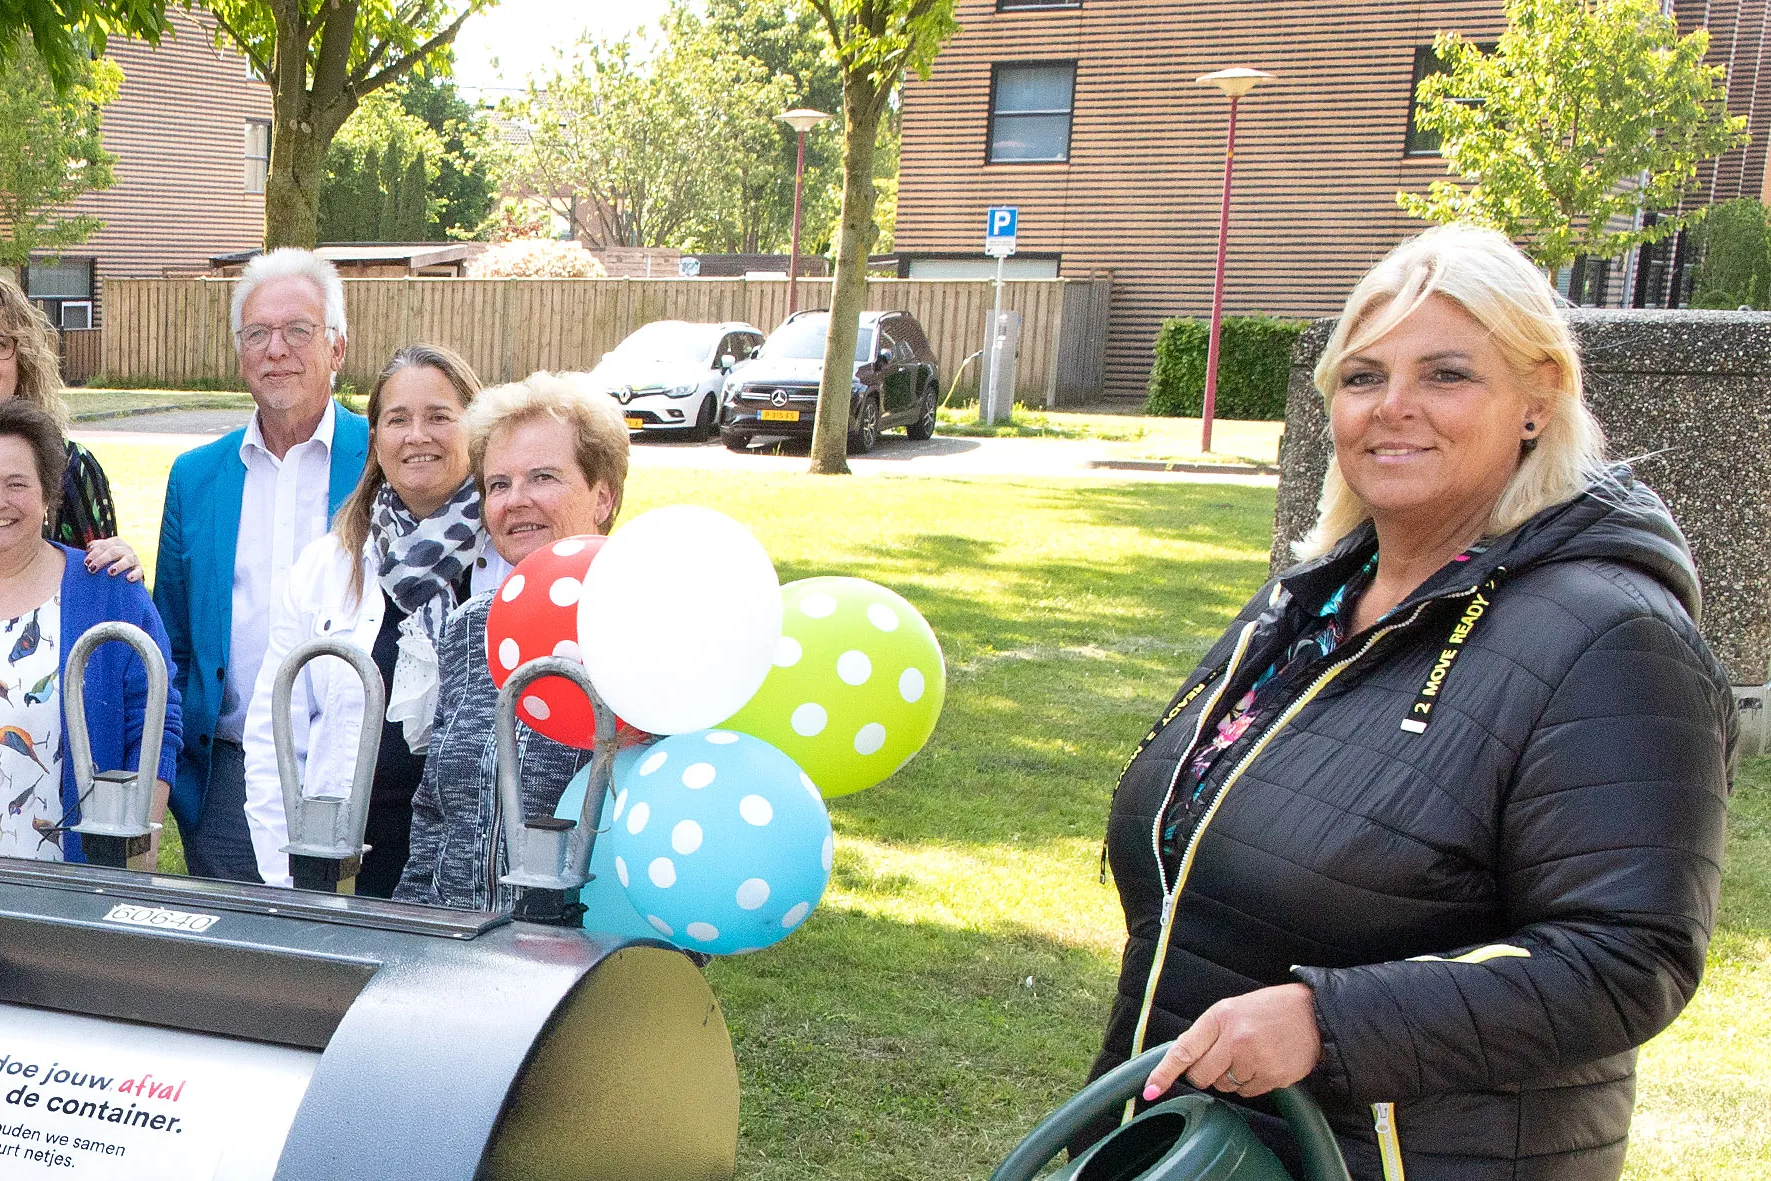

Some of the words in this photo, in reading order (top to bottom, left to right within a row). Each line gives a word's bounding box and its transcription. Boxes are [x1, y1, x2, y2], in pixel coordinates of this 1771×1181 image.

[994, 211, 1011, 235] P
[1449, 593, 1490, 643] READY
[1422, 649, 1457, 696] MOVE
[1162, 683, 1205, 726] READY
[1414, 702, 1431, 714] 2
[112, 907, 212, 930] 60640
[40, 1062, 113, 1092] jouw
[119, 1074, 186, 1102] afval
[6, 1085, 39, 1107] de
[47, 1095, 182, 1134] container.
[24, 1147, 75, 1168] netjes.
[46, 1132, 68, 1146] we
[73, 1137, 125, 1157] samen
